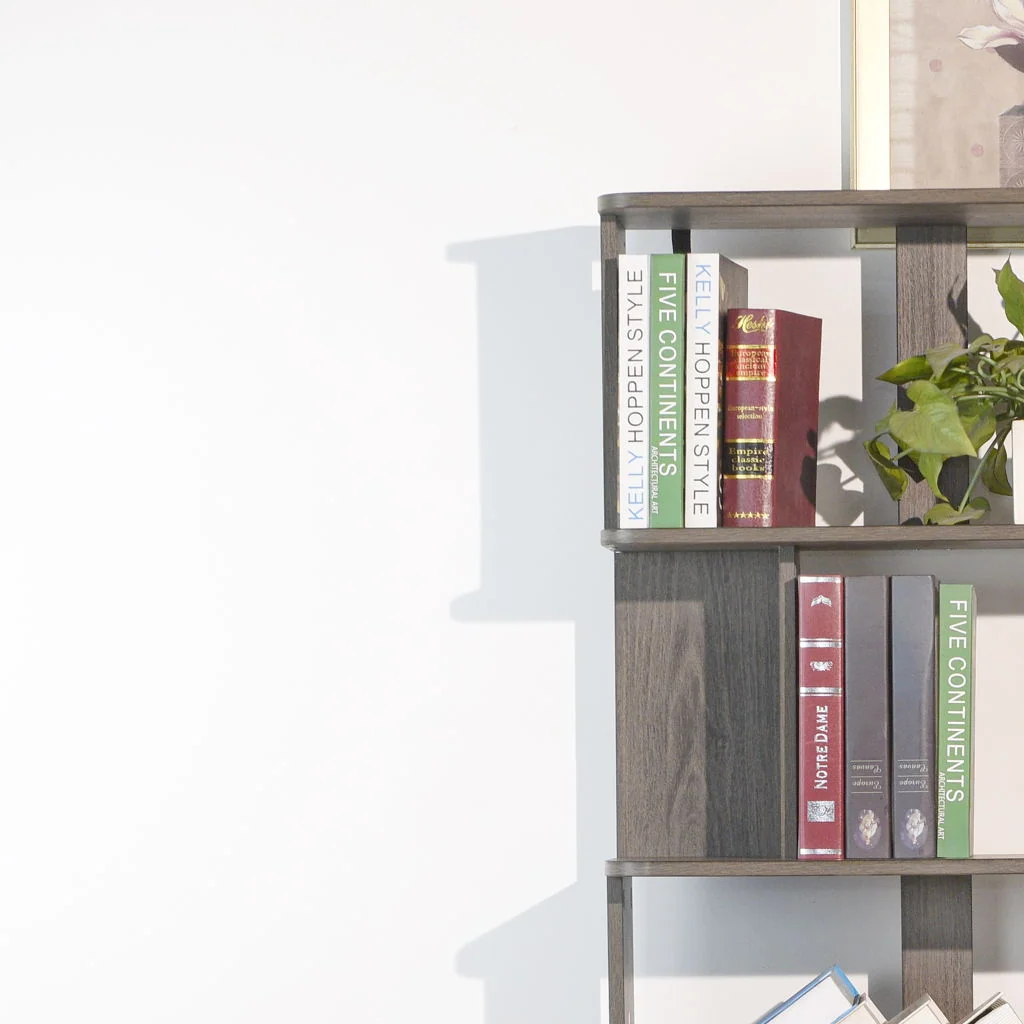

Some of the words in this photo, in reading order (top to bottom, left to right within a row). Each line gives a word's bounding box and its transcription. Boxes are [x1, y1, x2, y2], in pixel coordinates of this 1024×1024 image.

[627, 270, 643, 341] STYLE
[659, 273, 676, 322] FIVE
[696, 265, 711, 334] KELLY
[628, 348, 644, 442] HOPPEN
[659, 331, 677, 476] CONTINENTS
[694, 343, 710, 436] HOPPEN
[628, 451, 644, 520] KELLY
[651, 446, 659, 499] ARCHITECTURAL
[693, 444, 709, 515] STYLE
[729, 447, 769, 455] Empire
[949, 601, 966, 648] FIVE
[818, 705, 828, 744] DAME
[946, 657, 966, 802] CONTINENTS
[814, 745, 828, 789] NOTRE
[937, 772, 945, 826] ARCHITECTURAL
